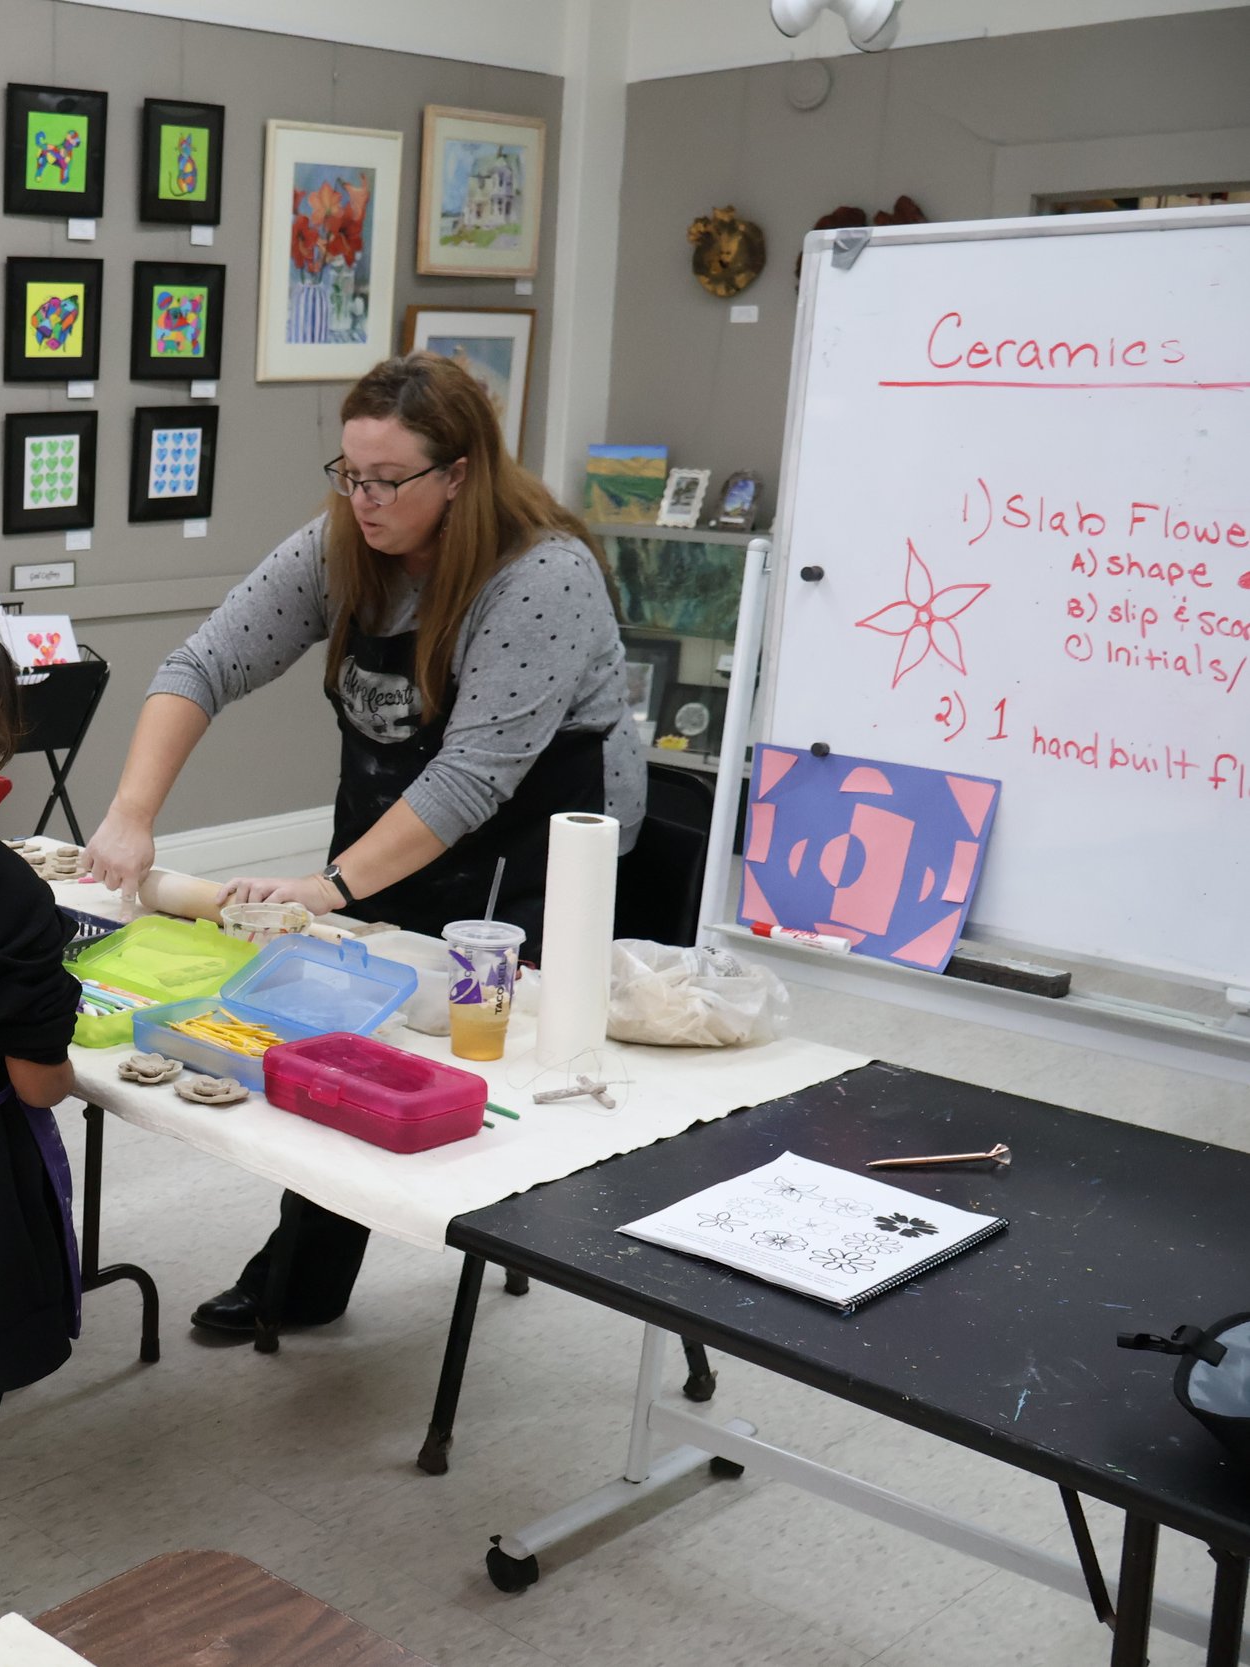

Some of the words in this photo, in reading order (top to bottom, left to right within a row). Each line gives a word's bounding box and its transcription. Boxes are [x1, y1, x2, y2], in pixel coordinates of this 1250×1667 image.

[927, 311, 1186, 370] Ceramics
[1002, 493, 1106, 538] Slab
[1071, 547, 1098, 578] A)
[1067, 592, 1098, 623] B)
[1107, 599, 1159, 639] slip
[934, 689, 967, 743] 2)
[986, 696, 1009, 742] 1
[494, 986, 505, 1016] TACO
